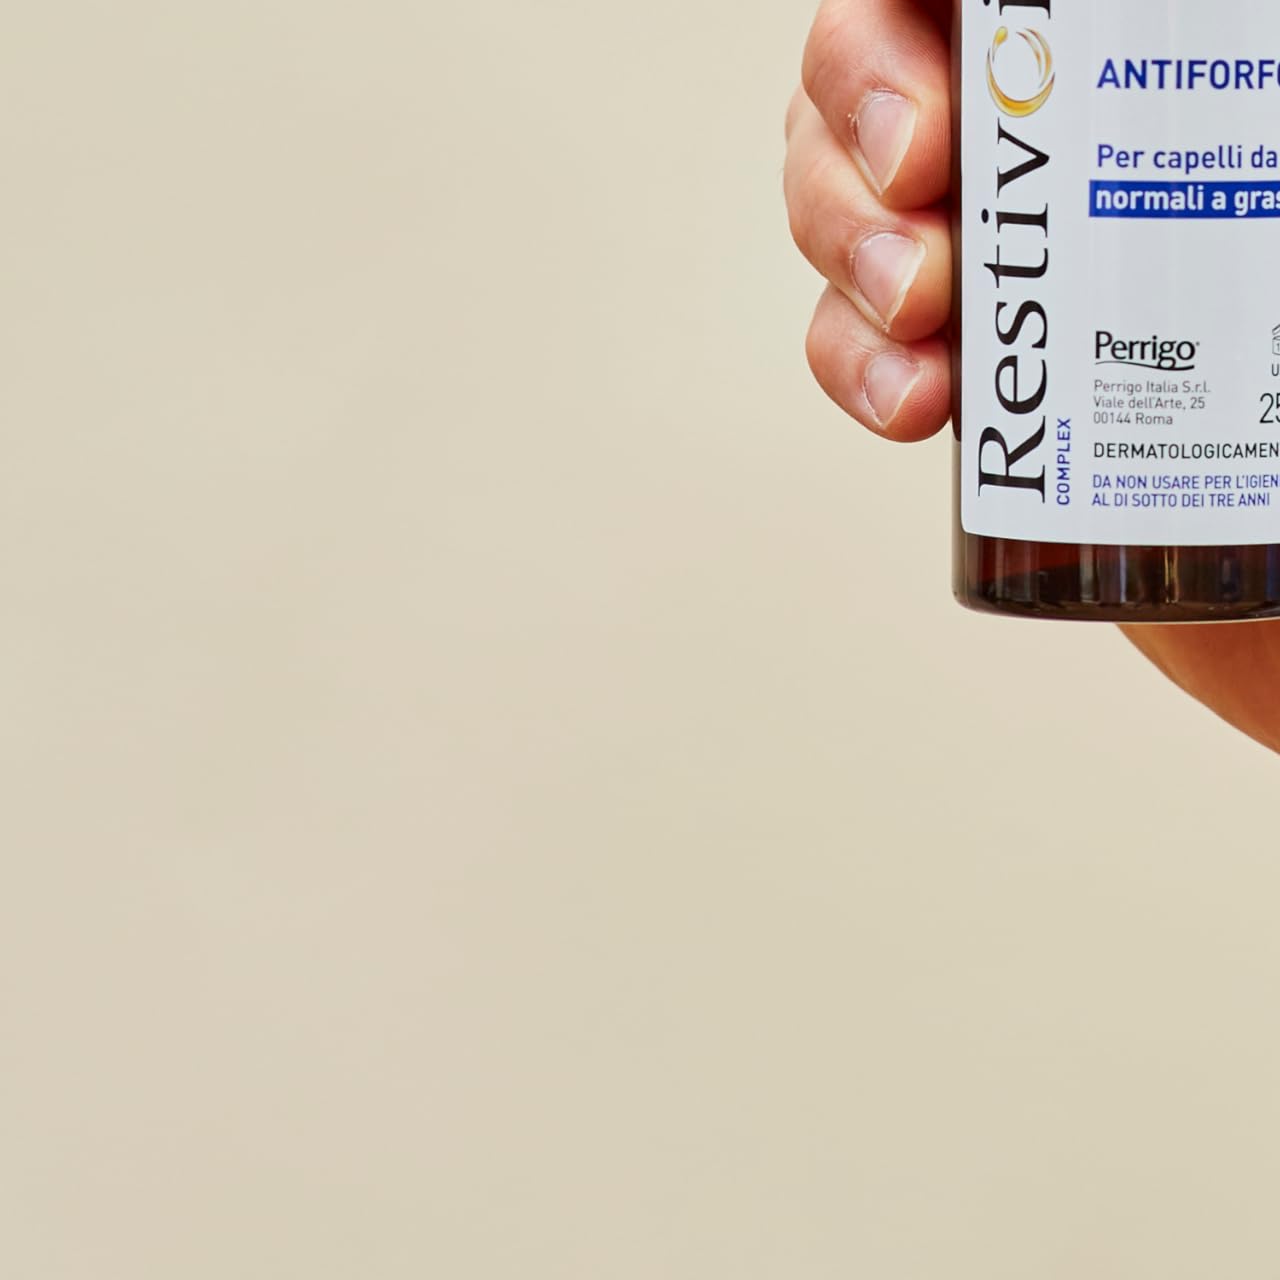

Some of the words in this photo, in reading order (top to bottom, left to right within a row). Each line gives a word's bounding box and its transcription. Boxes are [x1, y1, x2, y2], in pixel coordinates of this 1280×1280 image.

[1097, 144, 1145, 168] Per
[1153, 145, 1242, 175] capelli
[1251, 145, 1278, 169] da
[1096, 185, 1204, 210] normali
[1211, 190, 1226, 210] a
[1095, 330, 1196, 371] Perrigo
[1094, 379, 1143, 396] Perrigo
[1146, 380, 1178, 393] Italia
[1182, 381, 1211, 393] S.r.l.
[1093, 396, 1125, 409] Viale
[1190, 397, 1206, 410] 25
[1093, 412, 1131, 425] 00144
[1136, 412, 1173, 425] Roma
[1056, 417, 1071, 506] COMPLEX
[1092, 474, 1112, 489] DA
[1116, 475, 1147, 490] NON
[1152, 475, 1200, 490] USARE
[1205, 475, 1231, 490] PER
[1091, 492, 1110, 507] AL
[1114, 492, 1128, 507] DI
[1131, 493, 1178, 508] SOTTO
[1181, 493, 1205, 508] DEI
[1209, 493, 1235, 507] TRE
[1238, 492, 1270, 507] ANNI
